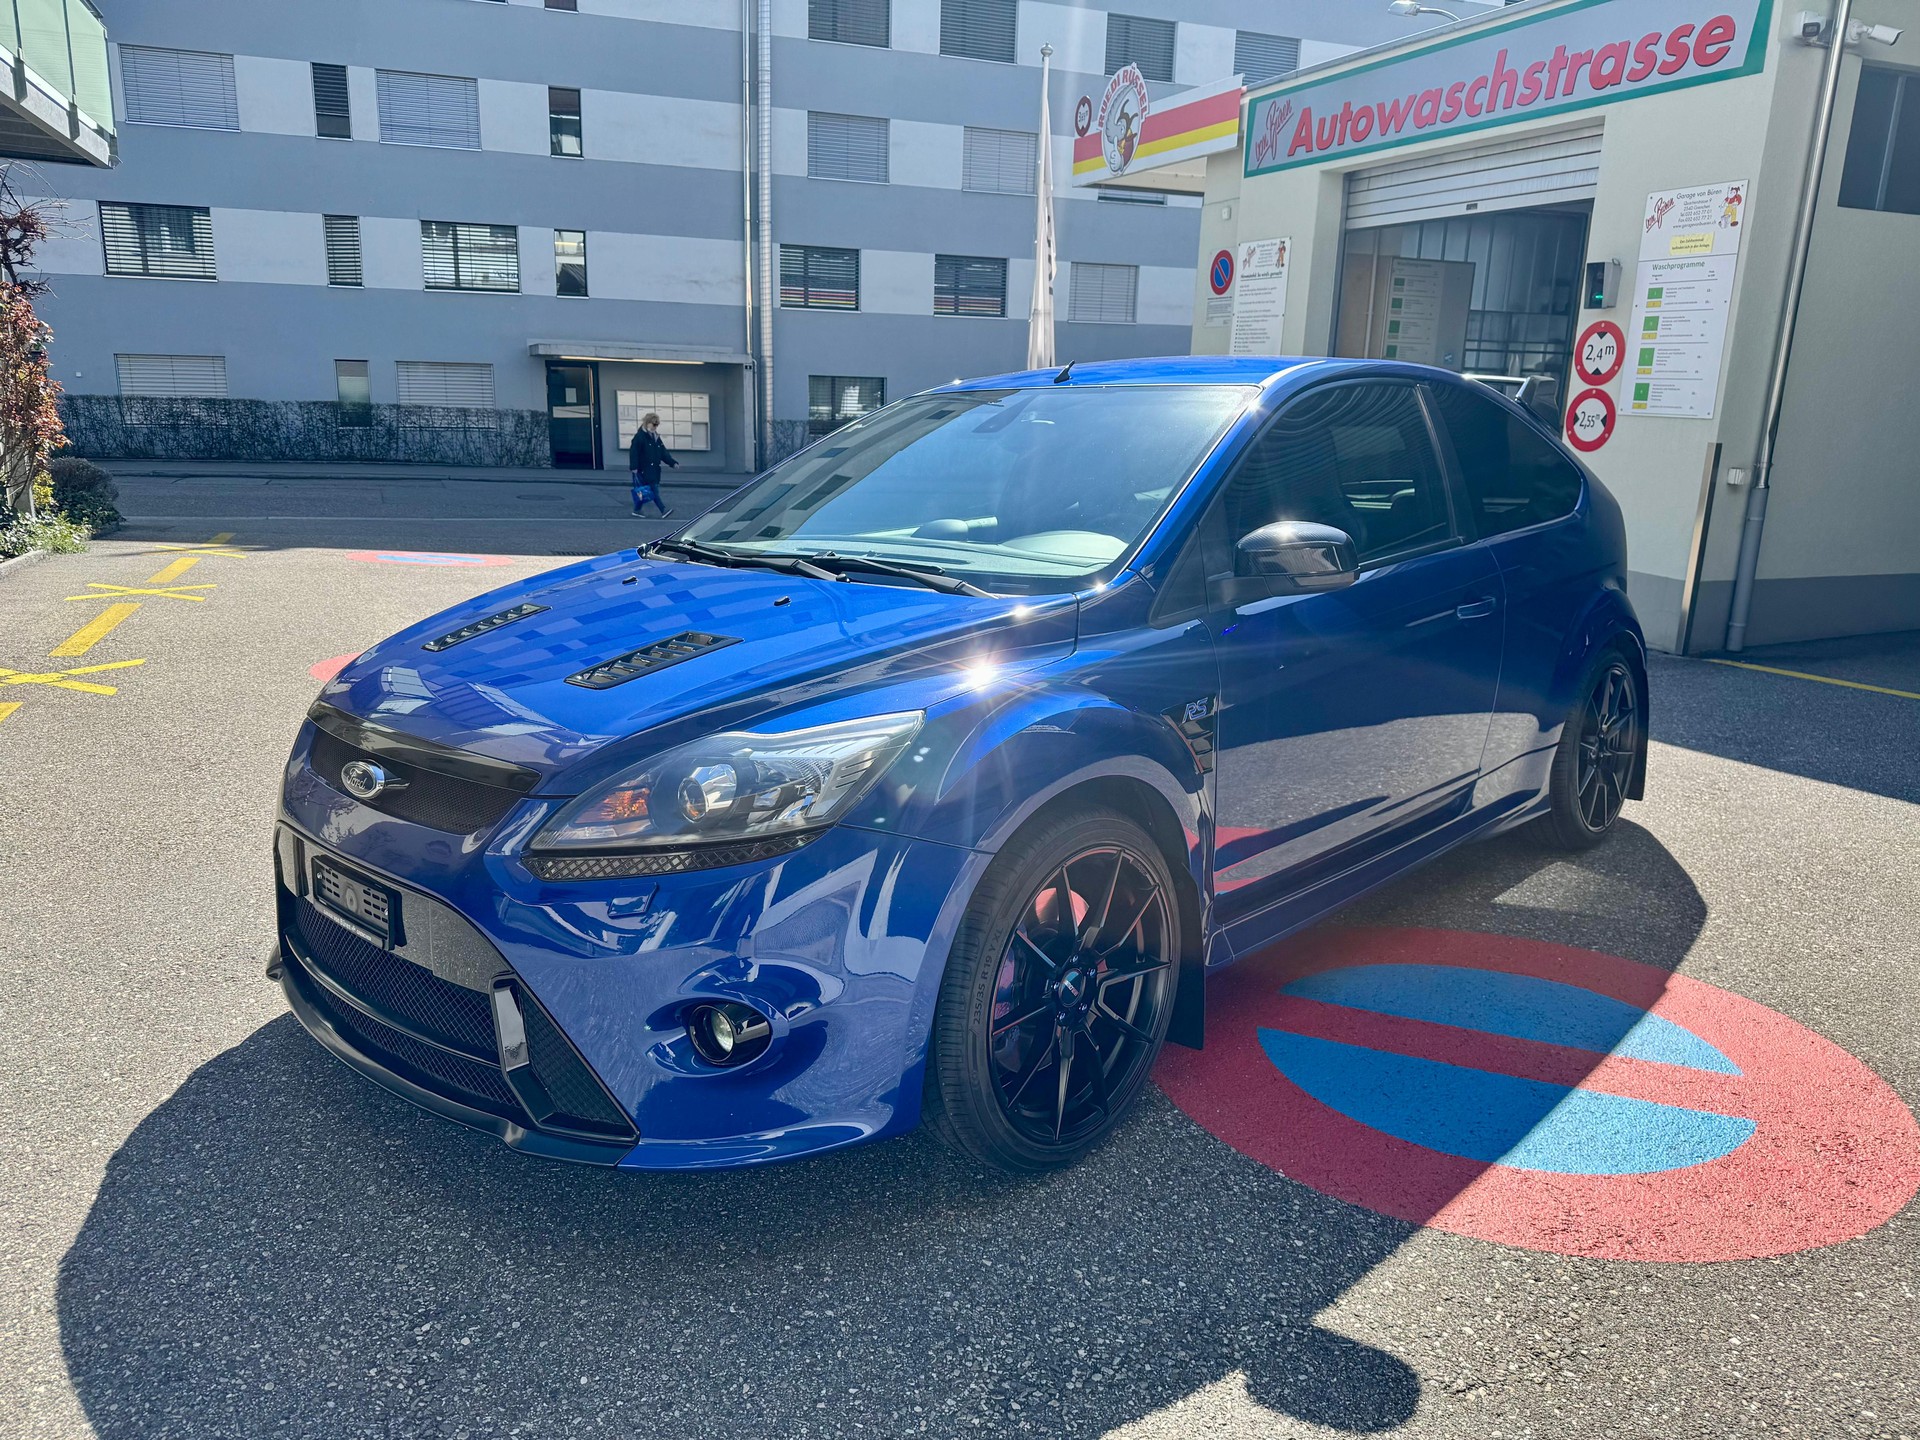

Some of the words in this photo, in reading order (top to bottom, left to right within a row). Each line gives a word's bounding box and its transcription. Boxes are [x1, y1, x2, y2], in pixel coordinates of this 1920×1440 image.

[1098, 73, 1121, 128] RUEDI
[1122, 65, 1148, 121] RÜSSEL
[1287, 14, 1736, 158] Autowaschstrasse
[1652, 261, 1705, 271] Waschprogramme
[1181, 696, 1209, 724] RS
[346, 767, 368, 790] Ford
[973, 983, 986, 1025] 235/35
